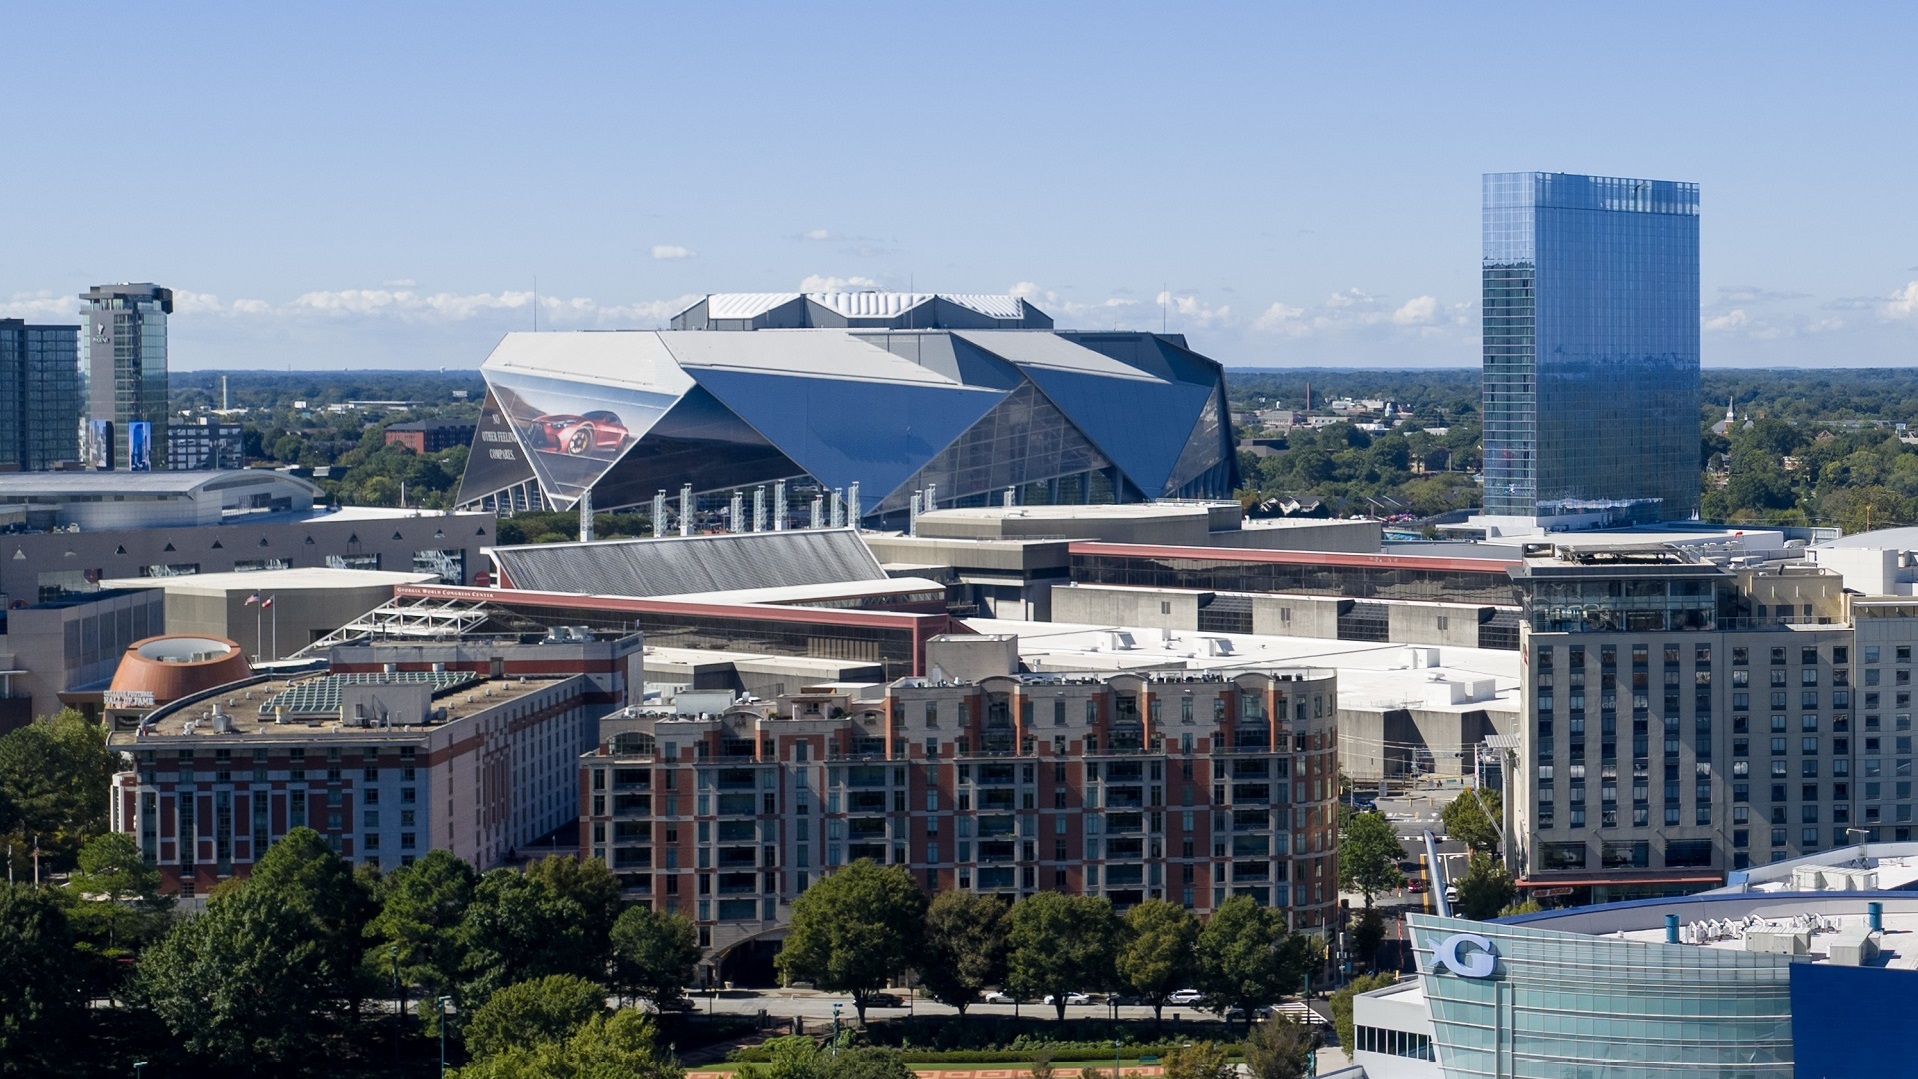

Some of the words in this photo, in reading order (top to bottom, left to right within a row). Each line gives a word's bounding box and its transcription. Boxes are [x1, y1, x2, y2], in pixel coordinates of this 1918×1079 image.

[482, 431, 497, 442] OTHER
[497, 431, 517, 443] FEELIN
[124, 697, 133, 705] OF
[134, 697, 154, 705] FAME
